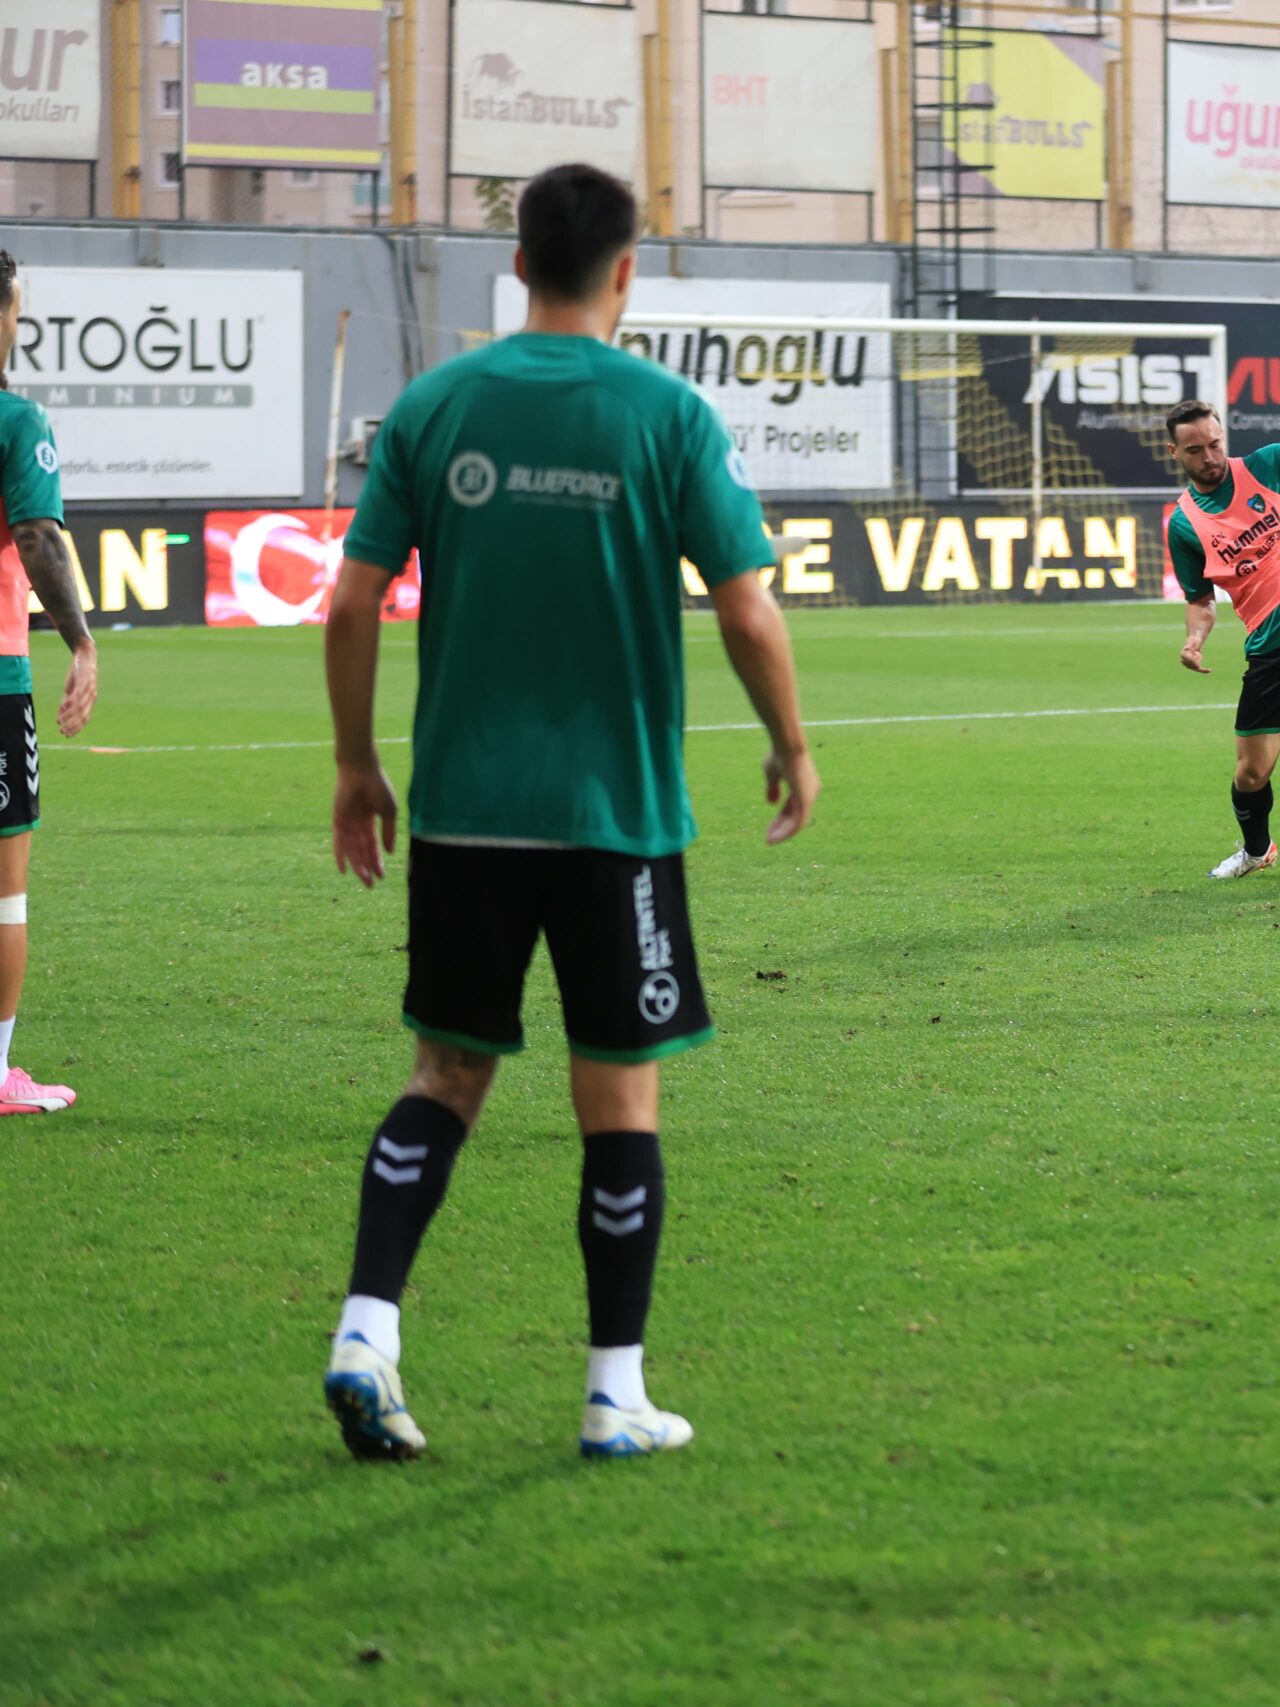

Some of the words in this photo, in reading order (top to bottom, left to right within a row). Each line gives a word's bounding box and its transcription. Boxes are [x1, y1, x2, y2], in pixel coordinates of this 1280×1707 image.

[241, 62, 329, 90] aksa
[712, 74, 768, 107] BHT
[765, 426, 861, 458] Projeler
[865, 516, 1138, 593] VATAN
